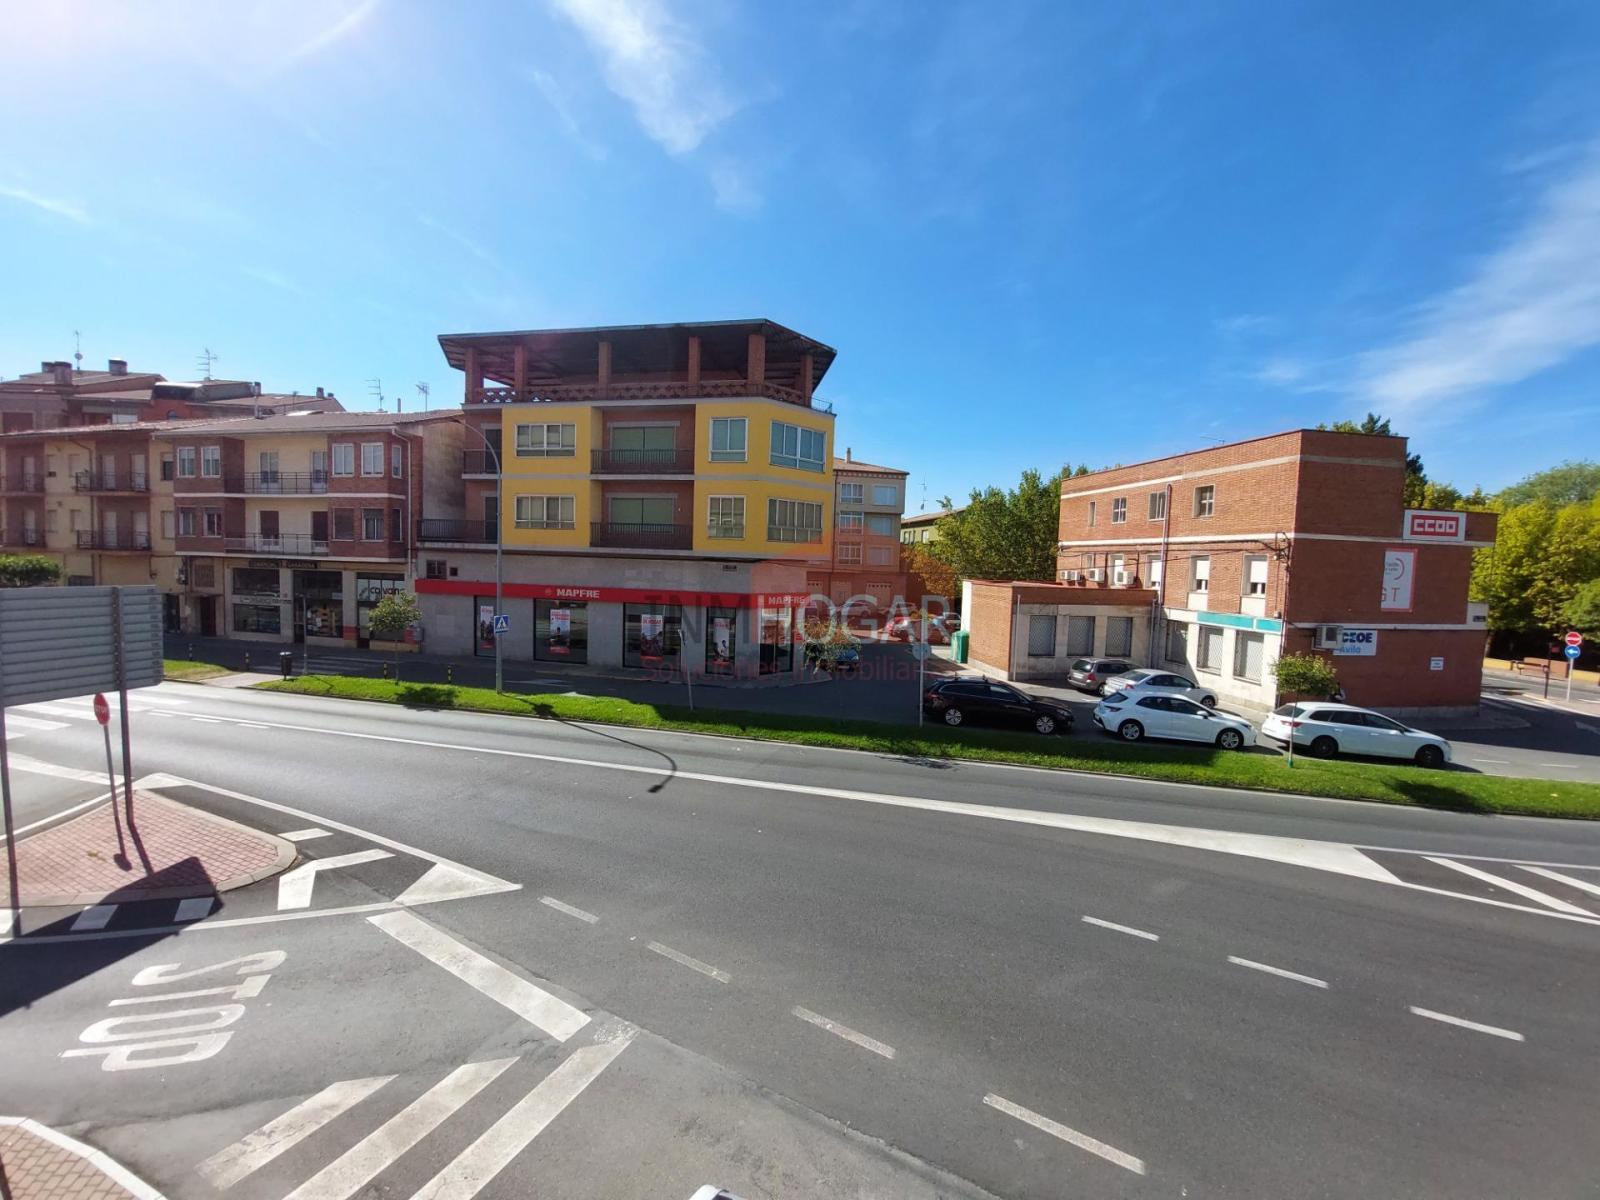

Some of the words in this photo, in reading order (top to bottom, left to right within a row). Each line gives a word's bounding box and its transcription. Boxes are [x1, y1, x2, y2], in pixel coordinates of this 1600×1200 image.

[1413, 519, 1456, 532] CCOO
[556, 588, 600, 599] MAPFRE
[768, 596, 806, 605] MAPFRE
[1342, 633, 1373, 643] CEOE
[57, 949, 288, 1072] STOP
